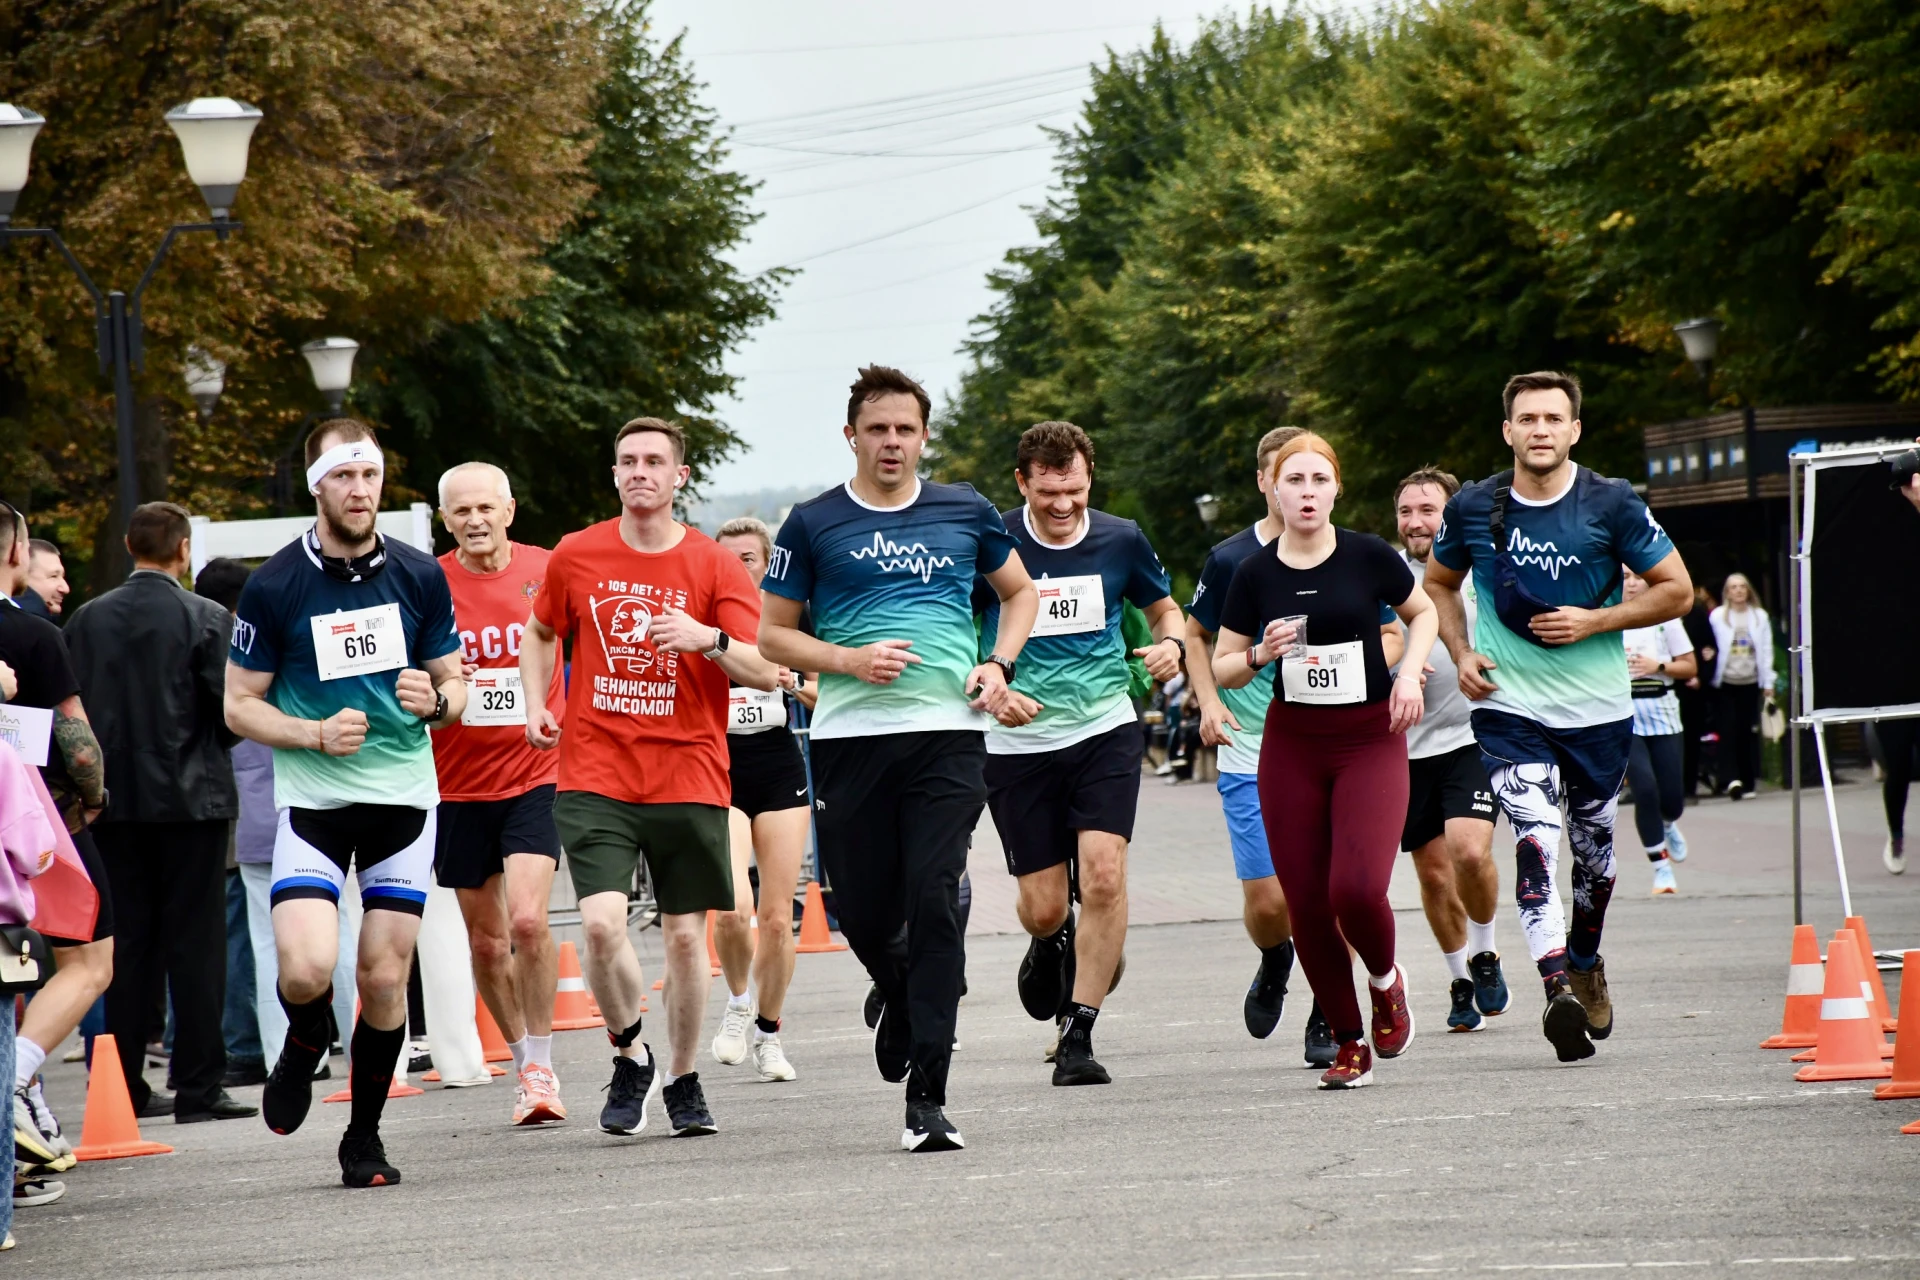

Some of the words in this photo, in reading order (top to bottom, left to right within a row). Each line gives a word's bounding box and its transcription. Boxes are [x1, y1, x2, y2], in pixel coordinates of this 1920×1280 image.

[608, 579, 628, 593] 105
[630, 583, 653, 596] ЛЕТ
[1049, 598, 1078, 619] 487
[344, 633, 377, 659] 616
[459, 622, 526, 663] ССС
[609, 646, 636, 655] ЛКСМ
[638, 648, 652, 658] РФ
[594, 675, 677, 698] ЛЕНИНСКИЙ
[1307, 667, 1338, 688] 691
[483, 690, 515, 710] 329
[592, 692, 675, 716] КОМСОМОЛ
[737, 706, 763, 724] 351
[1471, 802, 1493, 813] JAKO
[374, 877, 412, 885] SHIMANO
